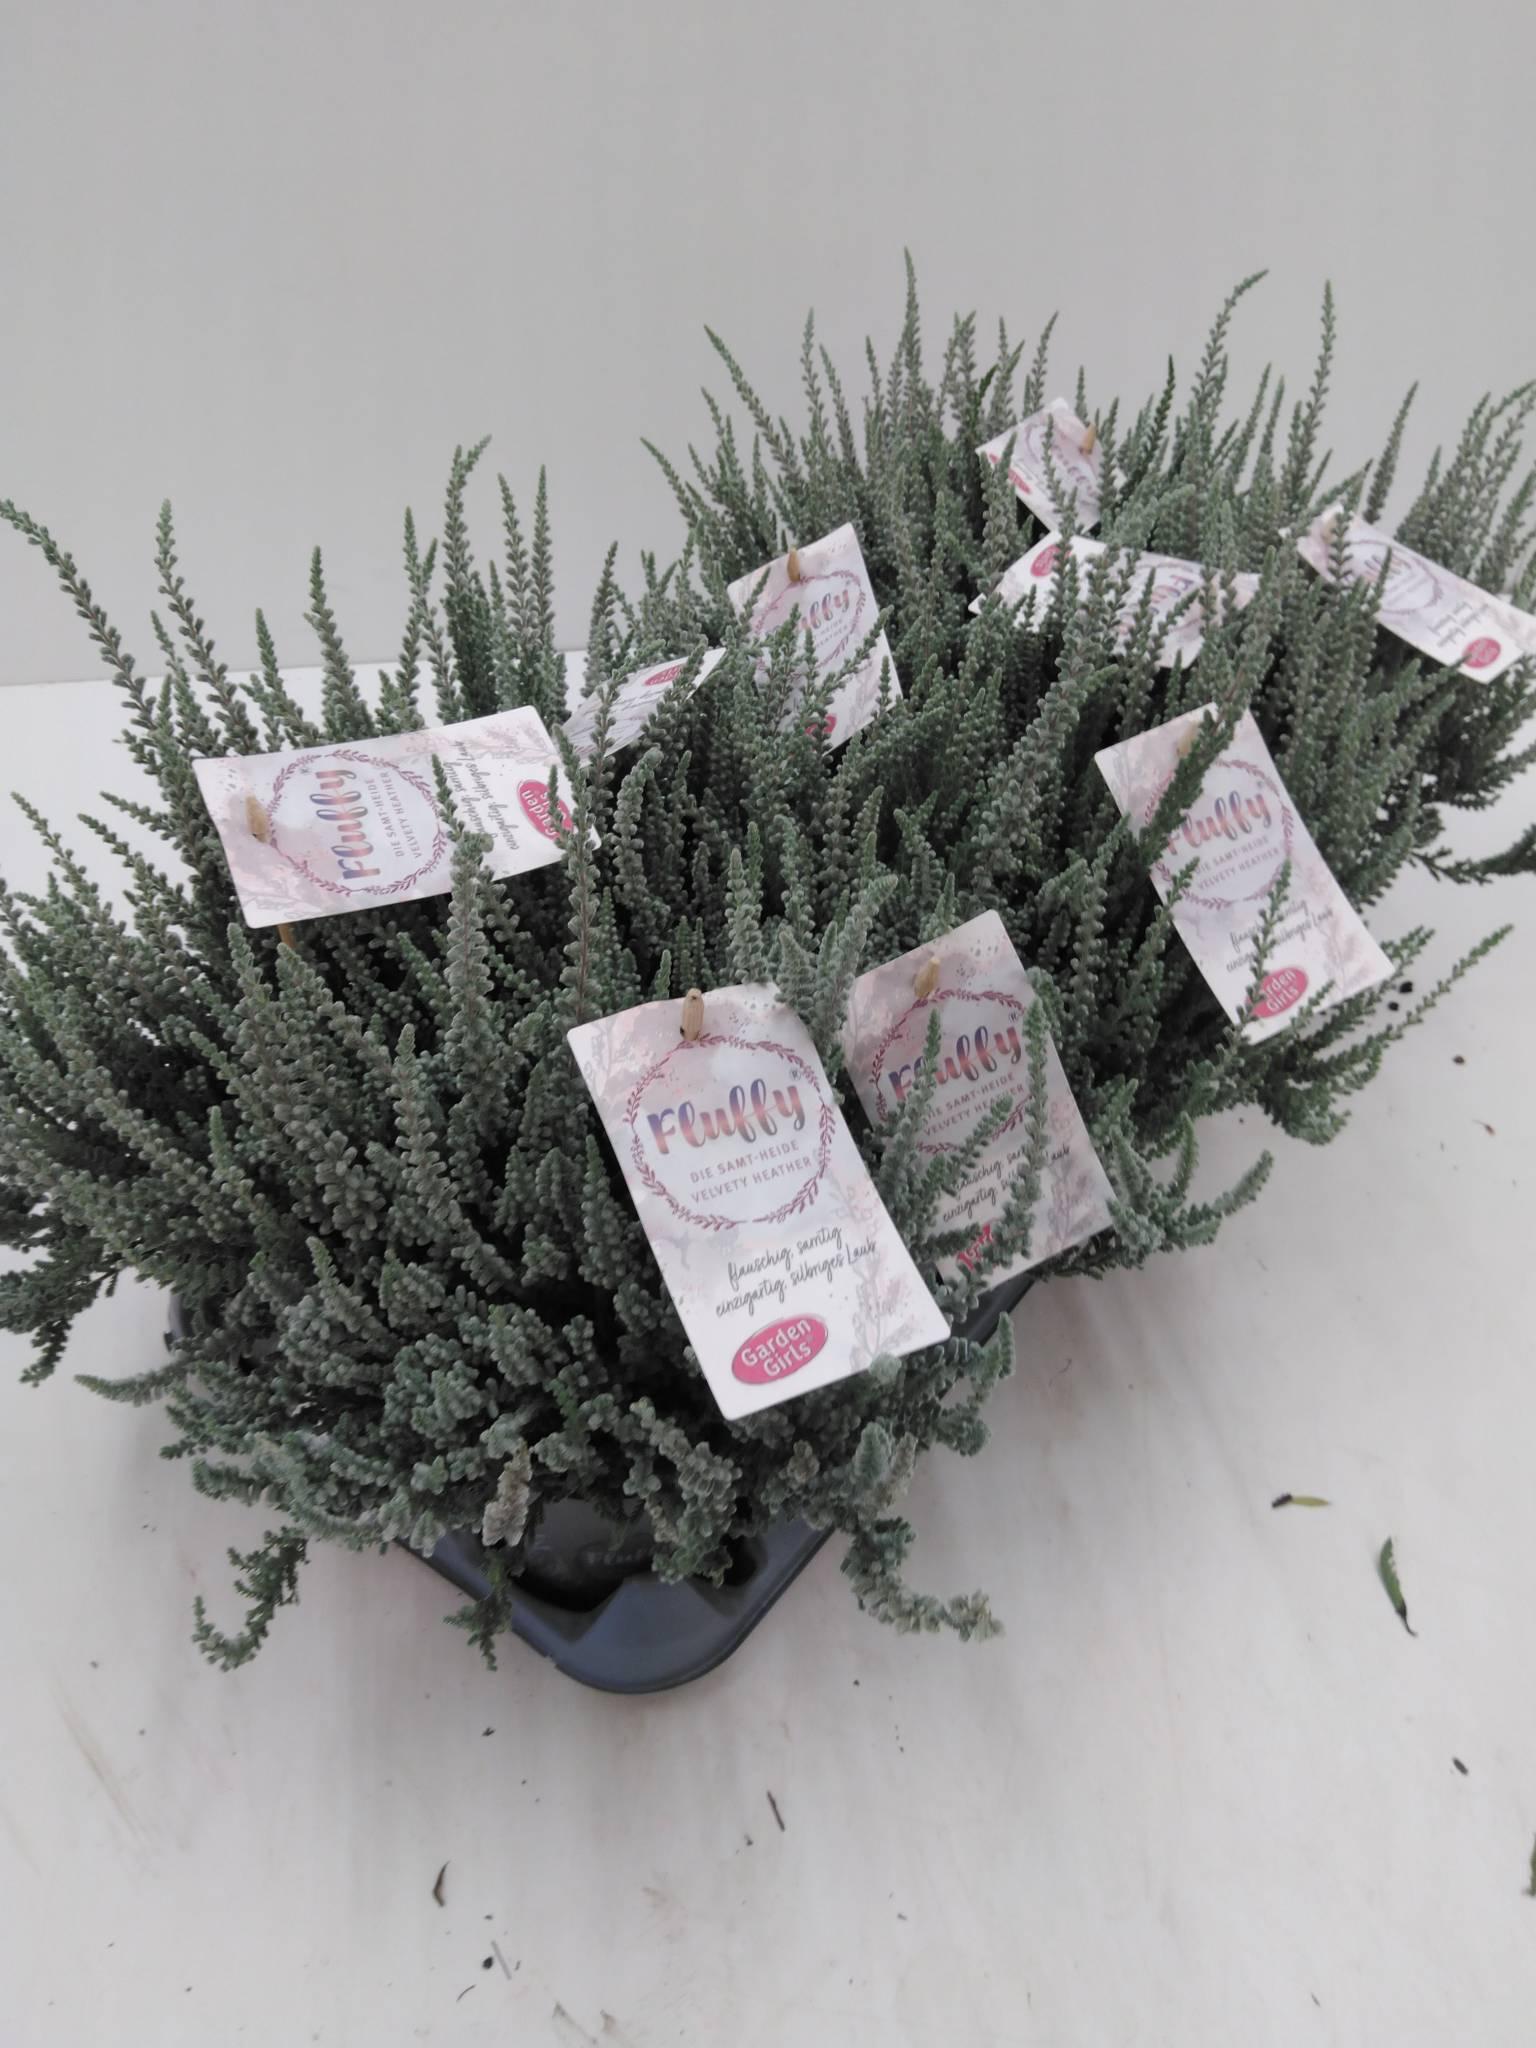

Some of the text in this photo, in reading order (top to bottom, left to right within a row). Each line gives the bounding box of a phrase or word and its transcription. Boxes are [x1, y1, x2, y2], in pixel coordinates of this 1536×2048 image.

[309, 769, 381, 880] Fluffy
[364, 779, 405, 858] DIE SAMT-HEIDE
[380, 771, 423, 859] VELVETY HEATHER
[646, 1078, 806, 1155] Fluffy
[924, 1109, 971, 1136] VELVETY
[690, 1140, 800, 1184] DIE SAMT-HEIDE
[691, 1156, 812, 1203] VELVETY HEATHER
[728, 1226, 842, 1292] flauschig, samtig
[790, 1257, 844, 1286] silbriges
[846, 1236, 877, 1266] Laub
[741, 1318, 812, 1367] Garden
[763, 1342, 812, 1377] Girls
